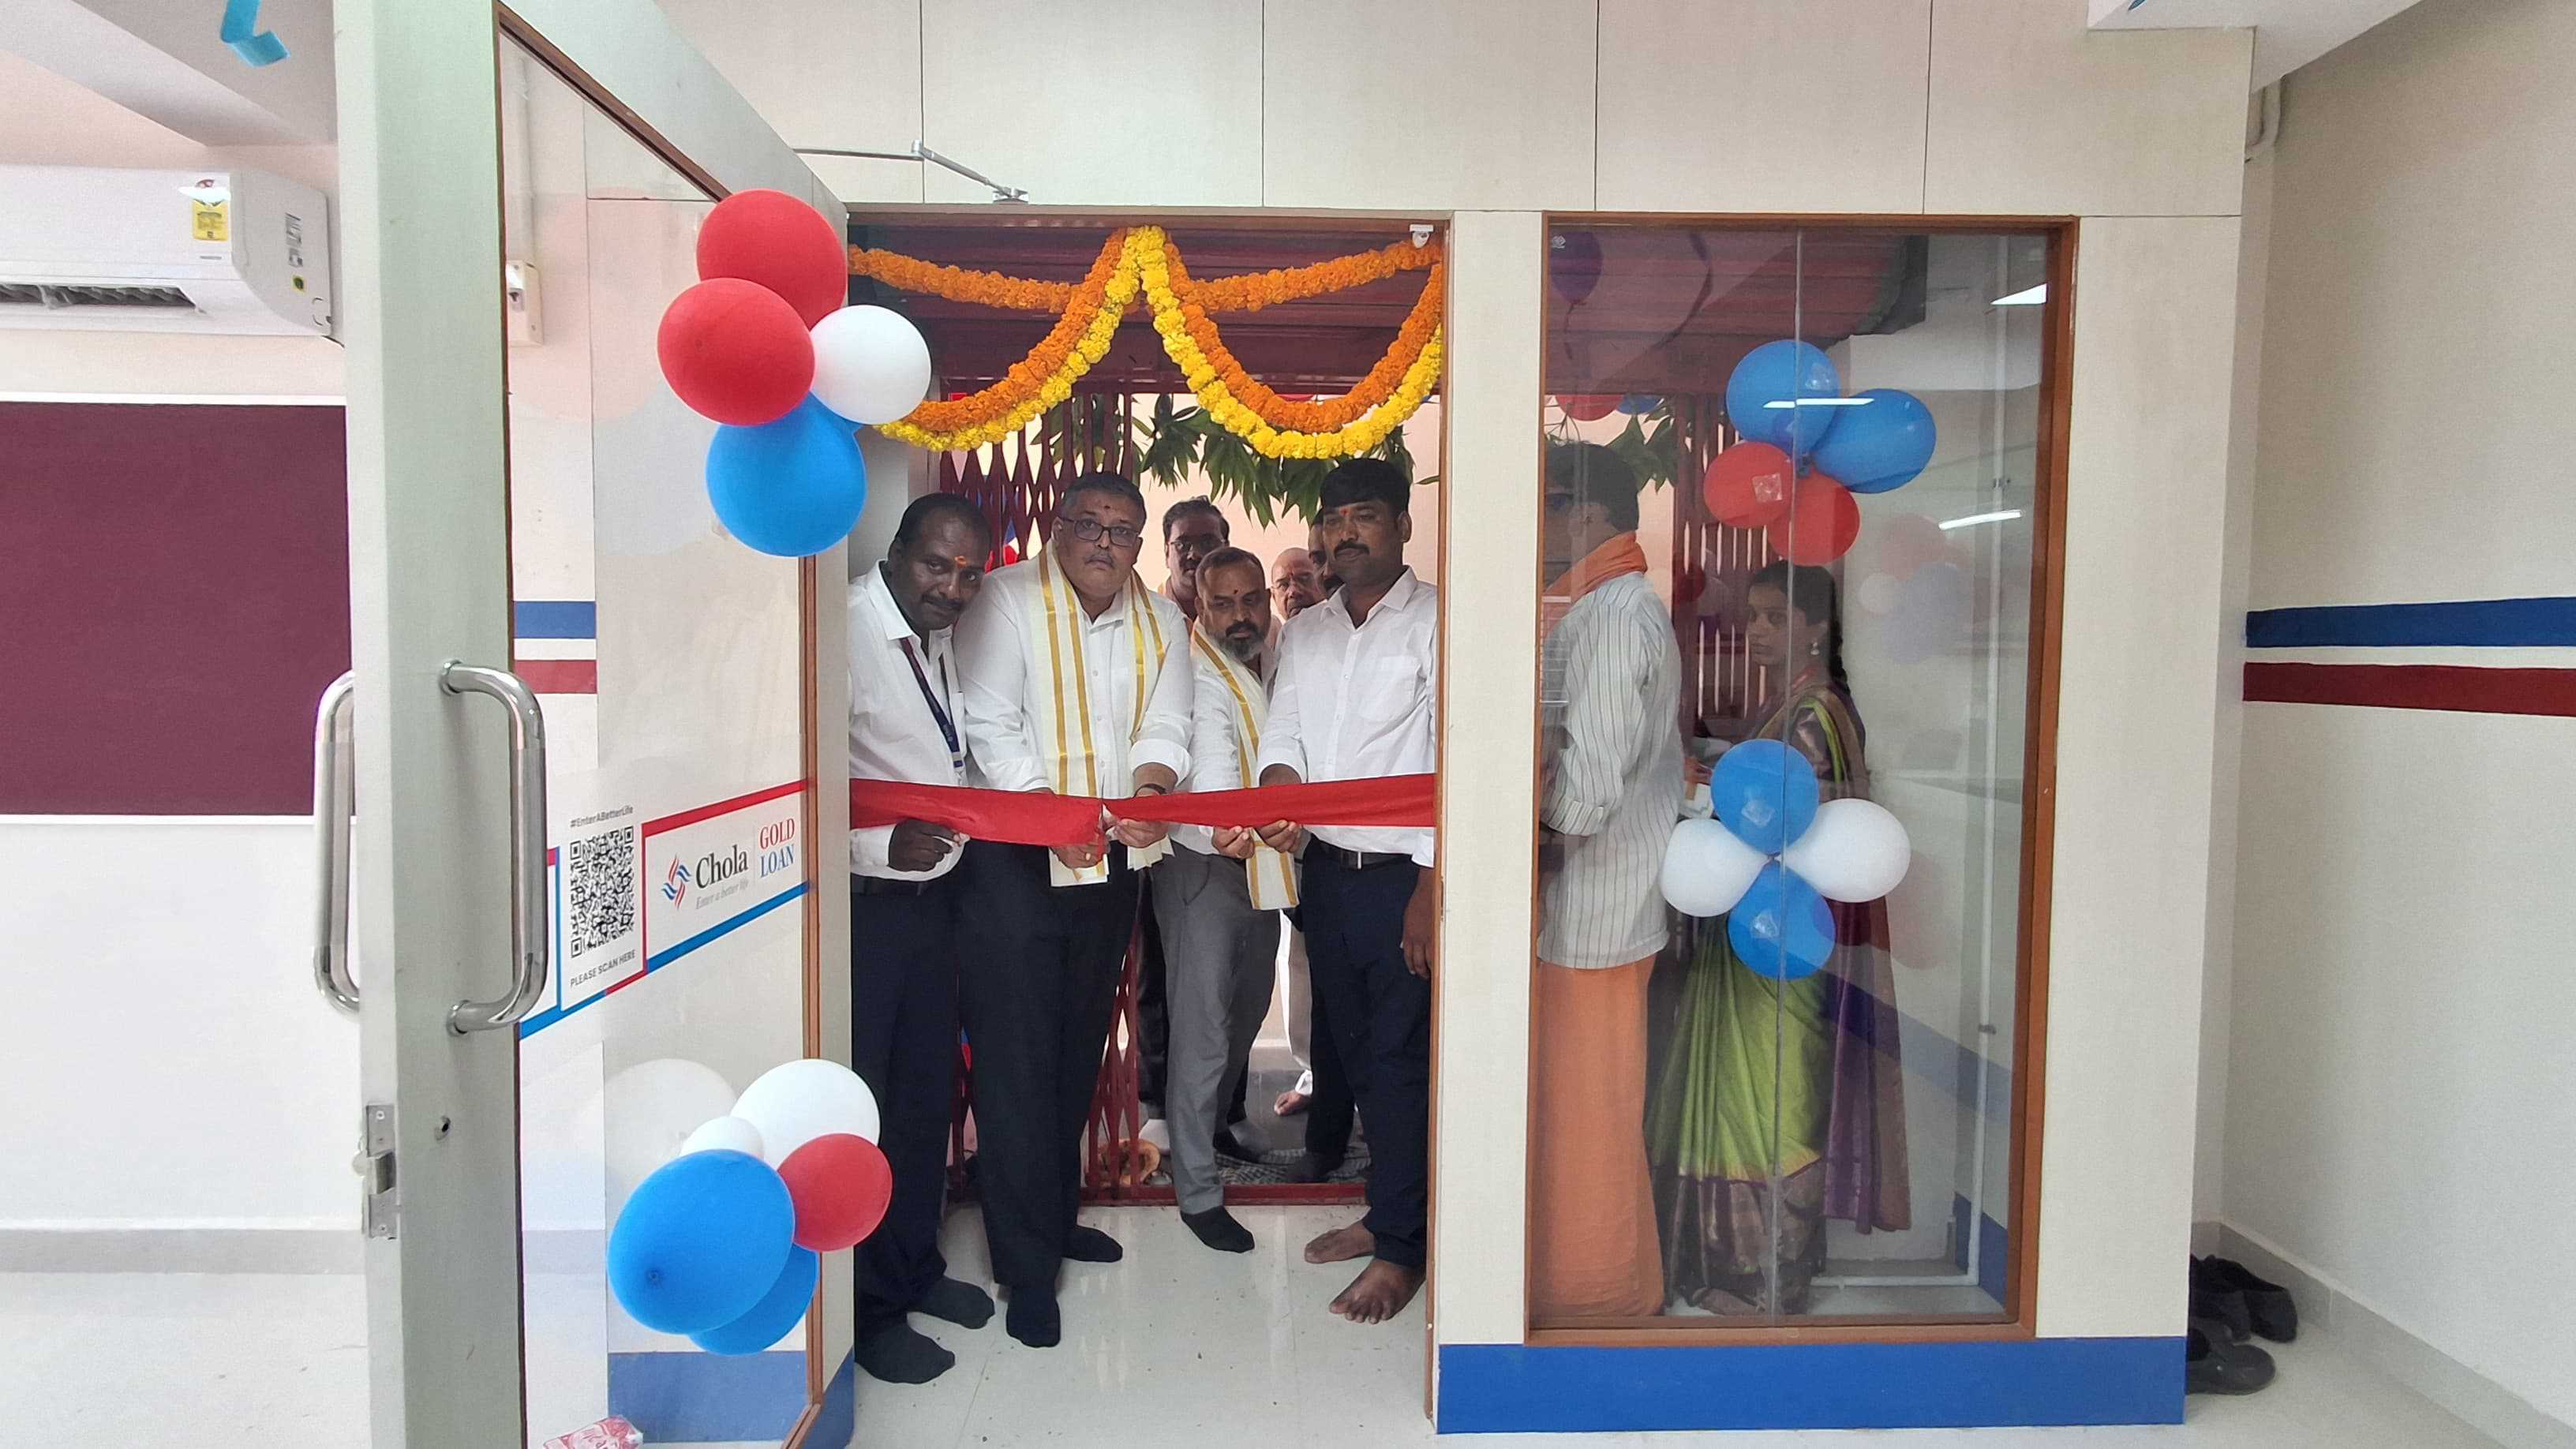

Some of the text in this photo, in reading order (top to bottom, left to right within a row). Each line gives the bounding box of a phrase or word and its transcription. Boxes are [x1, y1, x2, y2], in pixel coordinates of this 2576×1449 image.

[759, 818, 795, 849] GOLD
[696, 844, 748, 889] Chola
[759, 844, 794, 878] LOAN
[571, 949, 635, 987] PLEASE SCAN HERE
